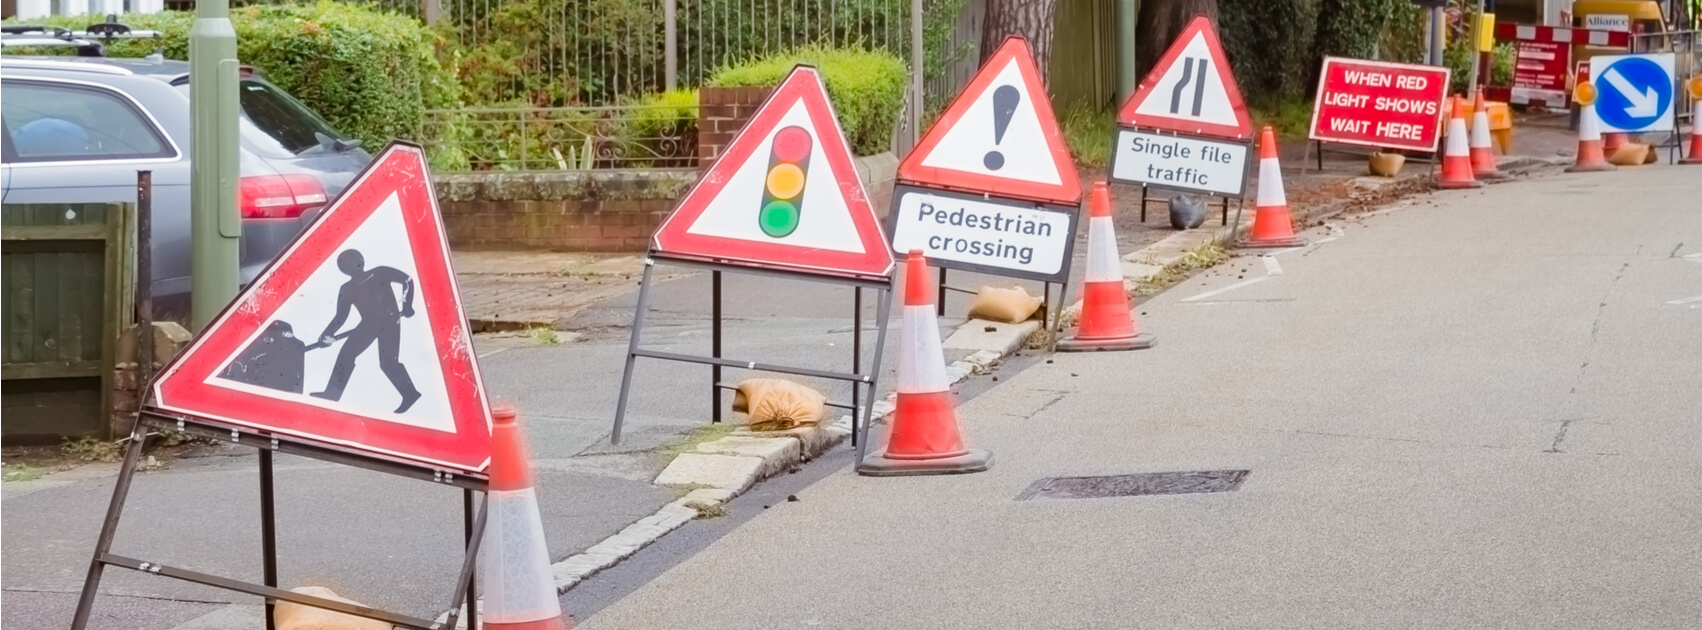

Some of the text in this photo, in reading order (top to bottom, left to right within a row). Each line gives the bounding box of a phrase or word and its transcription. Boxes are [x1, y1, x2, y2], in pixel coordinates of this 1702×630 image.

[1586, 16, 1628, 26] Alliance
[1344, 70, 1427, 90] WHEN RED
[1324, 91, 1437, 115] LIGHT SHOWS
[1330, 117, 1423, 140] WAIT HERE
[1131, 137, 1232, 164] Single file
[1147, 163, 1208, 185] traffic
[918, 202, 1052, 237] Pedestrian
[928, 234, 1034, 265] crossing
